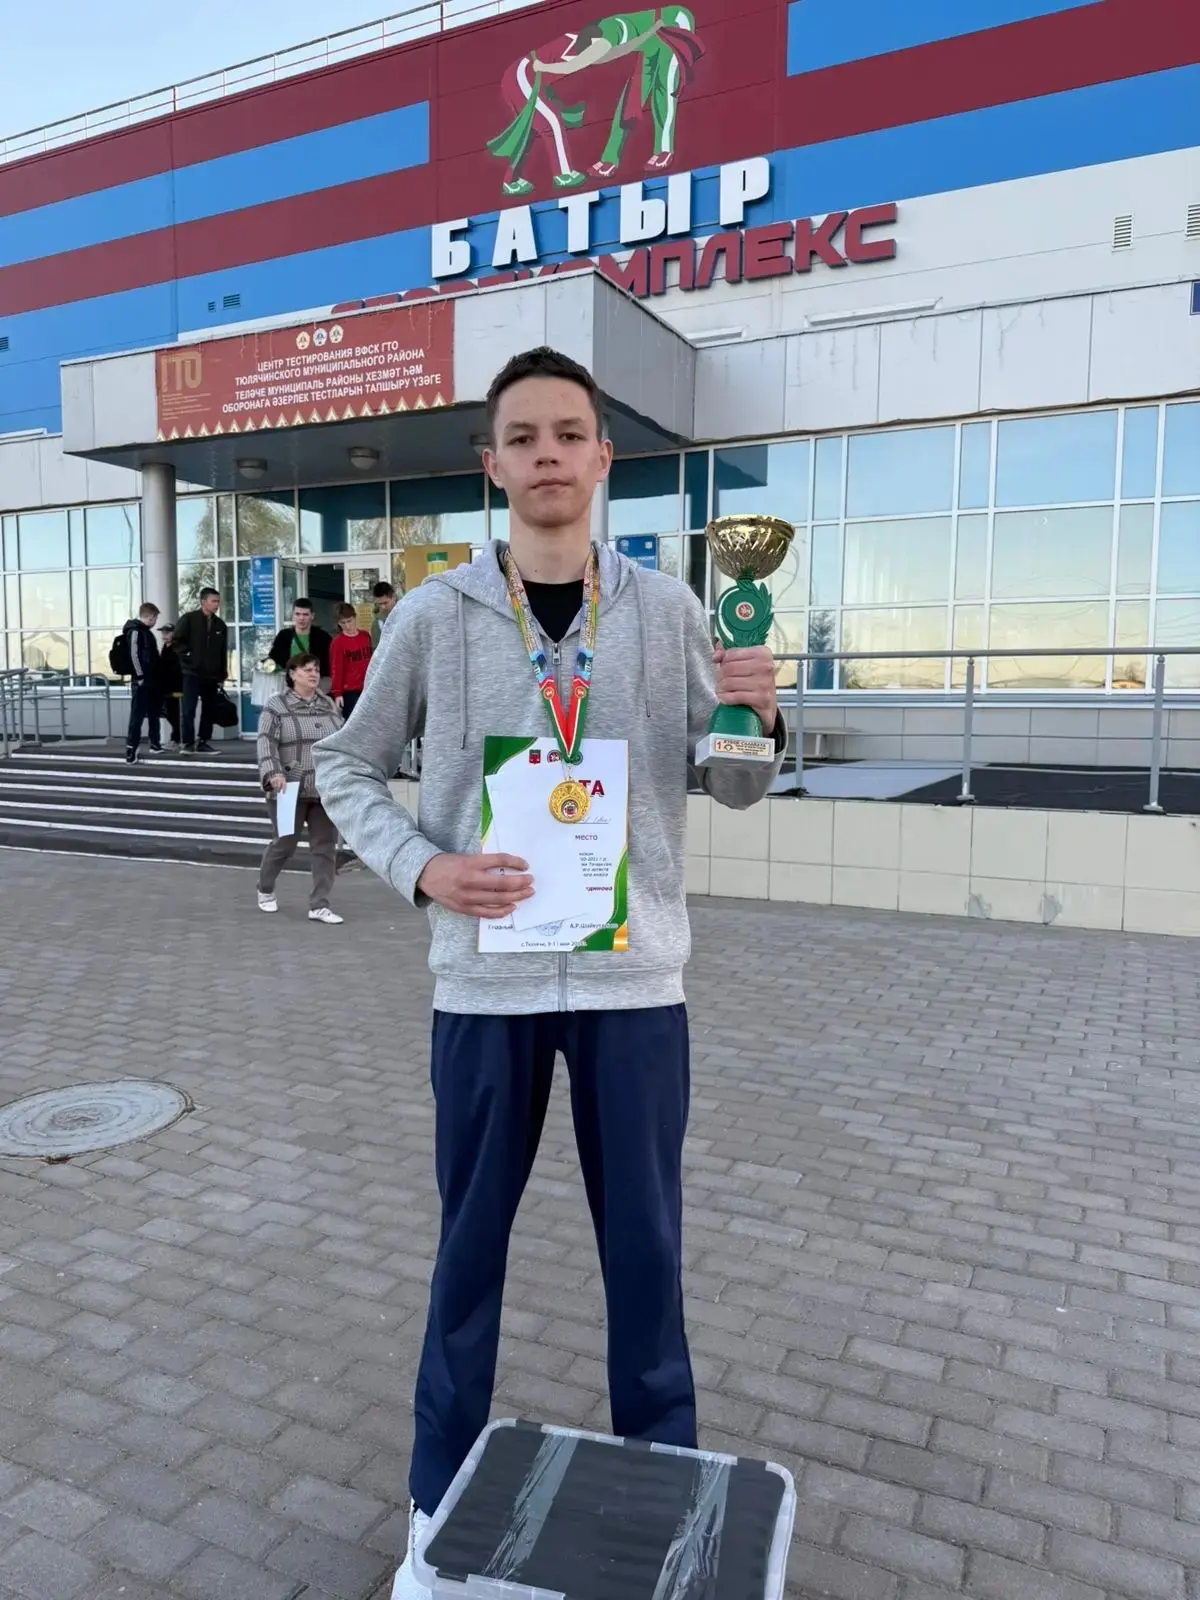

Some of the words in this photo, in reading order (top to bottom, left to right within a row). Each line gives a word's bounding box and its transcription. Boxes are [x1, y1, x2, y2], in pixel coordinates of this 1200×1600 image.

[431, 157, 770, 279] БАТЫР
[235, 368, 301, 386] ТЮЛЯЧИНСКОГО
[303, 356, 385, 376] МУНИЦИПАЛЬНОГО
[387, 348, 425, 364] РАЙОНА
[257, 359, 284, 372] ЦЕНТР
[286, 348, 353, 367] ТЕСТИРОВАНИЯ
[355, 344, 380, 356] ВФСК
[381, 340, 399, 352] ГТО
[222, 399, 271, 413] ОБОРОНАГА
[272, 393, 309, 406] ӘЗЕРЛЕК
[310, 385, 363, 401] ТЕСТЛАРЫН
[365, 378, 410, 393] ТАПШЫРУ
[235, 388, 267, 400] ТЕЛӘЧЕ
[267, 380, 324, 396] МУНИЦИПАЛЬ
[326, 373, 363, 388] РАЙОНЫ
[365, 367, 401, 382] ХЕЗМӘТ
